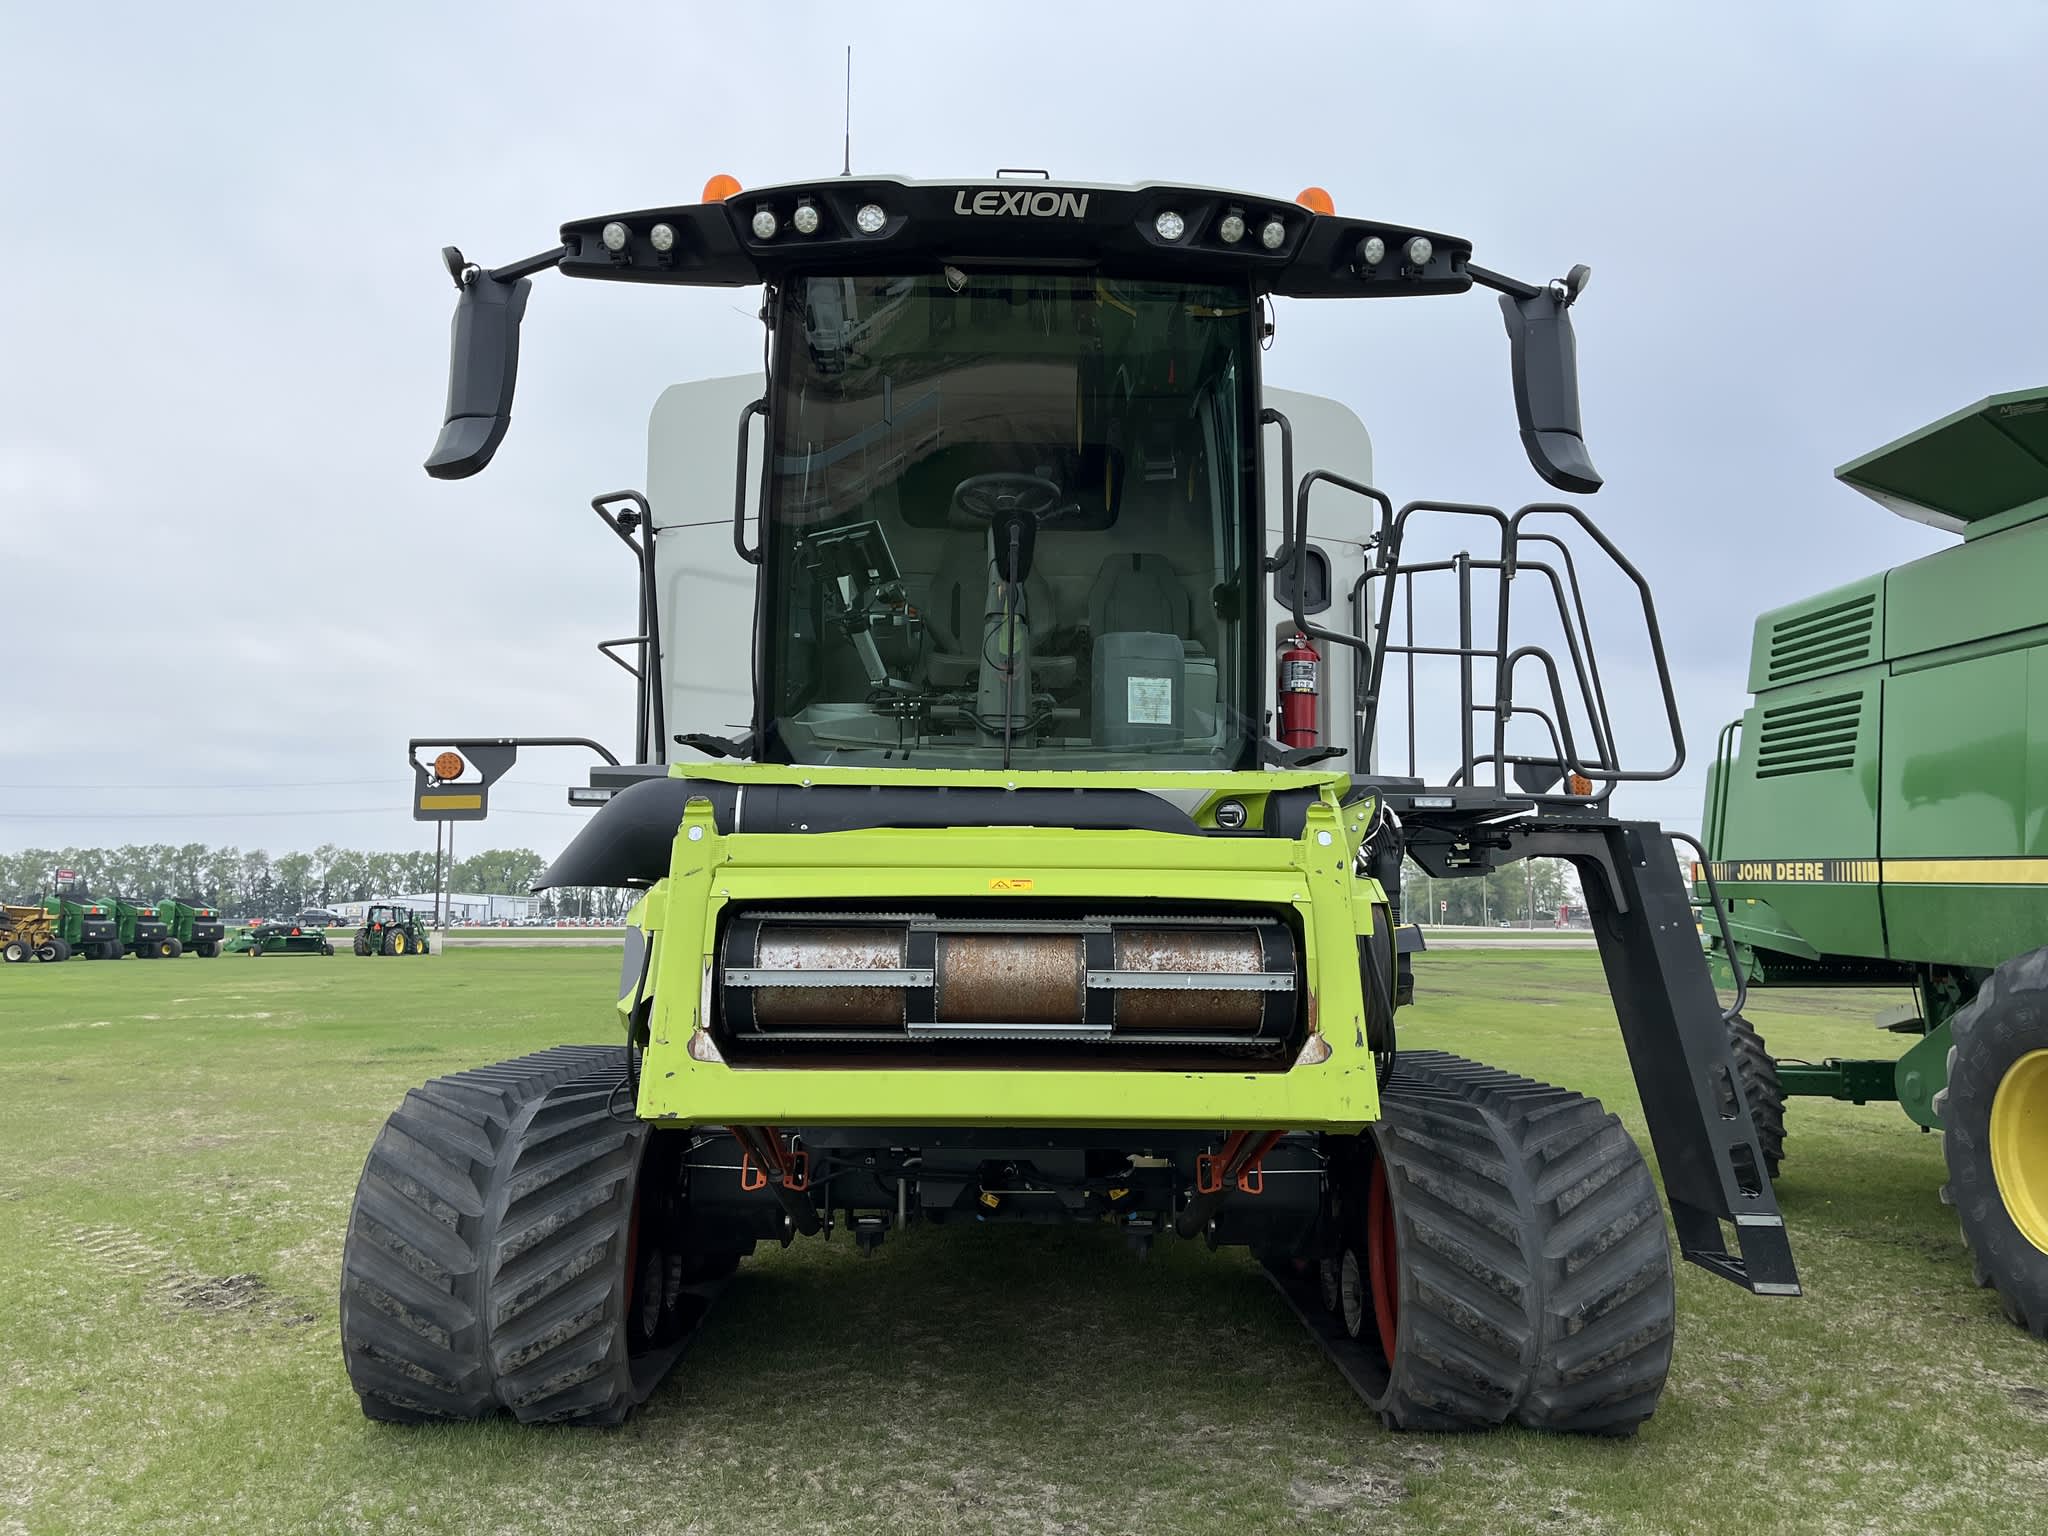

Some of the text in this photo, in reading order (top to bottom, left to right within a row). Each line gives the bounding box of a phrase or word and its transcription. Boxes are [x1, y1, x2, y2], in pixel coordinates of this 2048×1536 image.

[954, 190, 1090, 218] LEXION
[1737, 862, 1824, 881] JOHN DEERE
